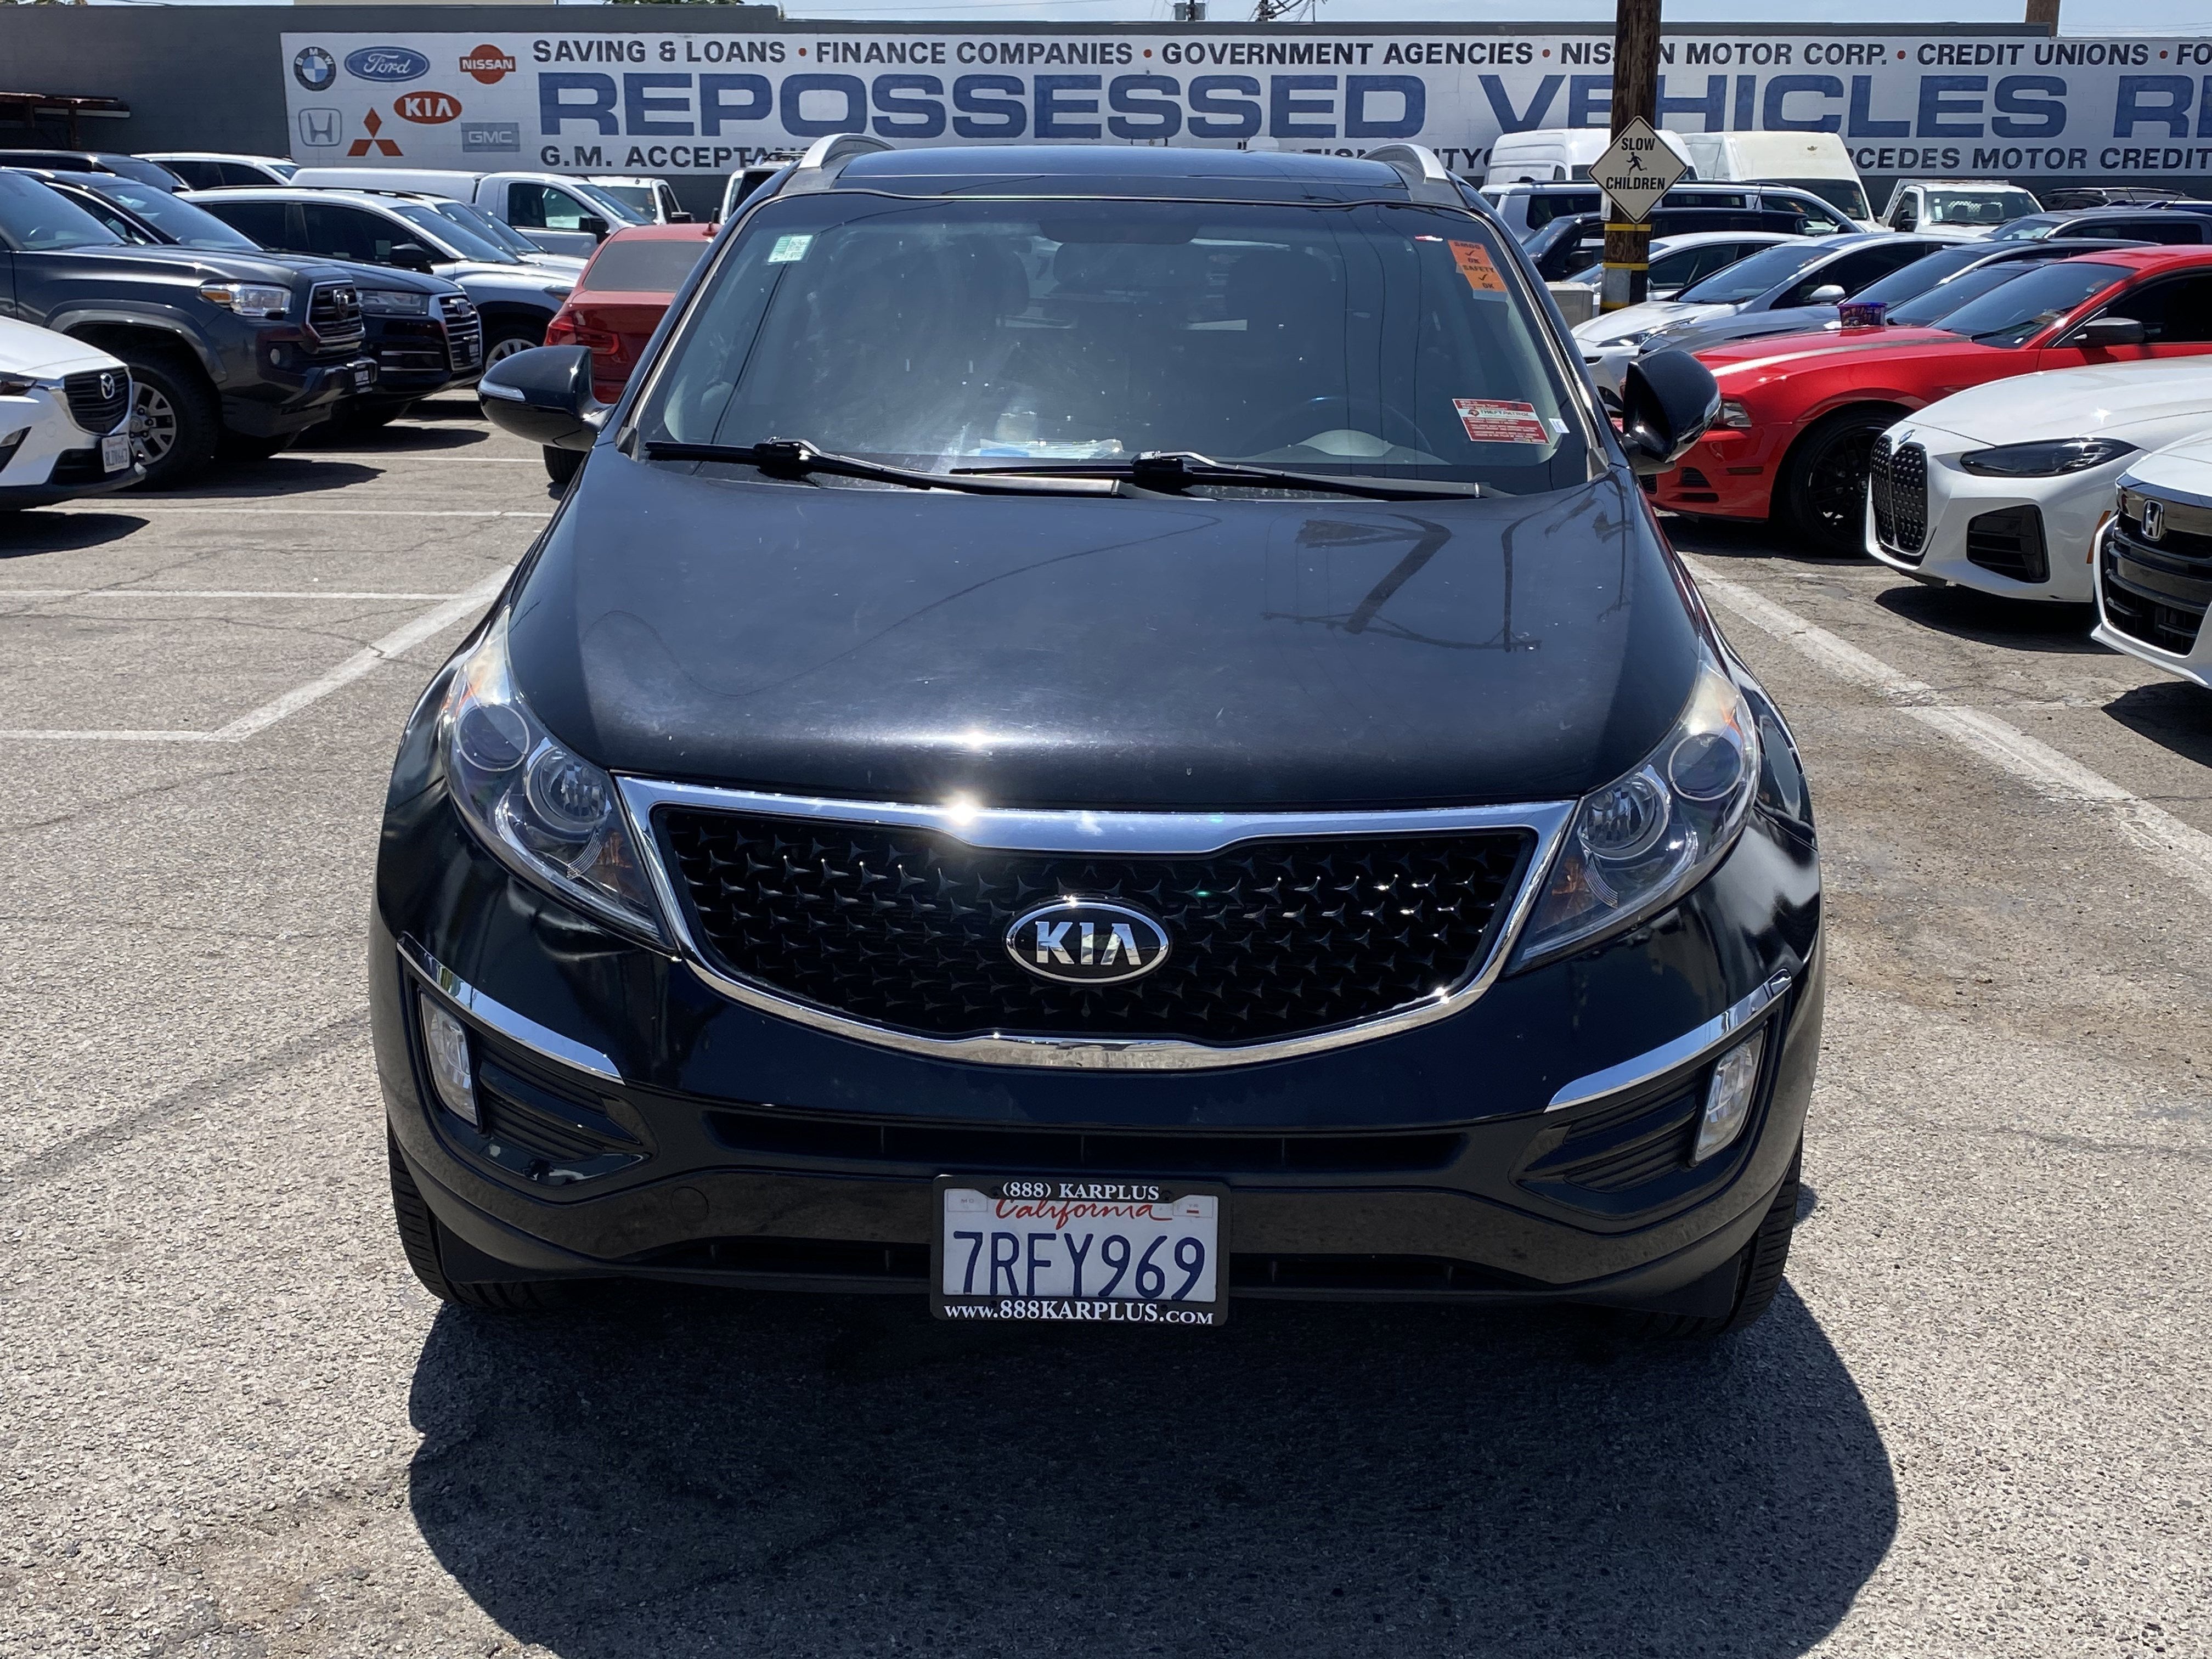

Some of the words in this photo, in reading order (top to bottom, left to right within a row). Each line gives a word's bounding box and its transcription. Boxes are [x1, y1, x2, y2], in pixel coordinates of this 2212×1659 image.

[532, 40, 646, 63] SAVING
[659, 41, 676, 63] &
[687, 41, 786, 63] LOANS
[816, 42, 946, 64] FINANCE
[956, 42, 1132, 64] COMPANIES
[1162, 42, 1373, 65] GOVERNMENT
[1383, 42, 1533, 65] AGENCIES
[1560, 42, 1675, 65] NISN
[1686, 43, 1792, 65] MOTOR
[1804, 43, 1887, 65] CORP.
[1917, 43, 2025, 65] CREDIT
[2034, 43, 2149, 65] UNIONS
[363, 53, 410, 74] Ford
[462, 59, 514, 70] NISSAN
[403, 97, 454, 117] KIA
[538, 72, 1426, 139] REPOSSESSED
[1478, 74, 2067, 138] VEHICLES
[469, 131, 512, 144] GMC
[1621, 137, 1656, 151] SLOW
[541, 145, 612, 167] G.M.
[1846, 148, 1961, 170] CEDES
[1972, 148, 2086, 170] MOTOR
[2100, 148, 2212, 170] CREDIT
[1606, 176, 1666, 190] CHILDREN
[1454, 241, 1481, 250] SMOG
[1035, 921, 1142, 966] KIA
[1002, 1182, 1052, 1198] (888)
[1059, 1183, 1159, 1200] KARPLUS
[996, 1199, 1173, 1230] California
[953, 1231, 1205, 1301] 7RFY969
